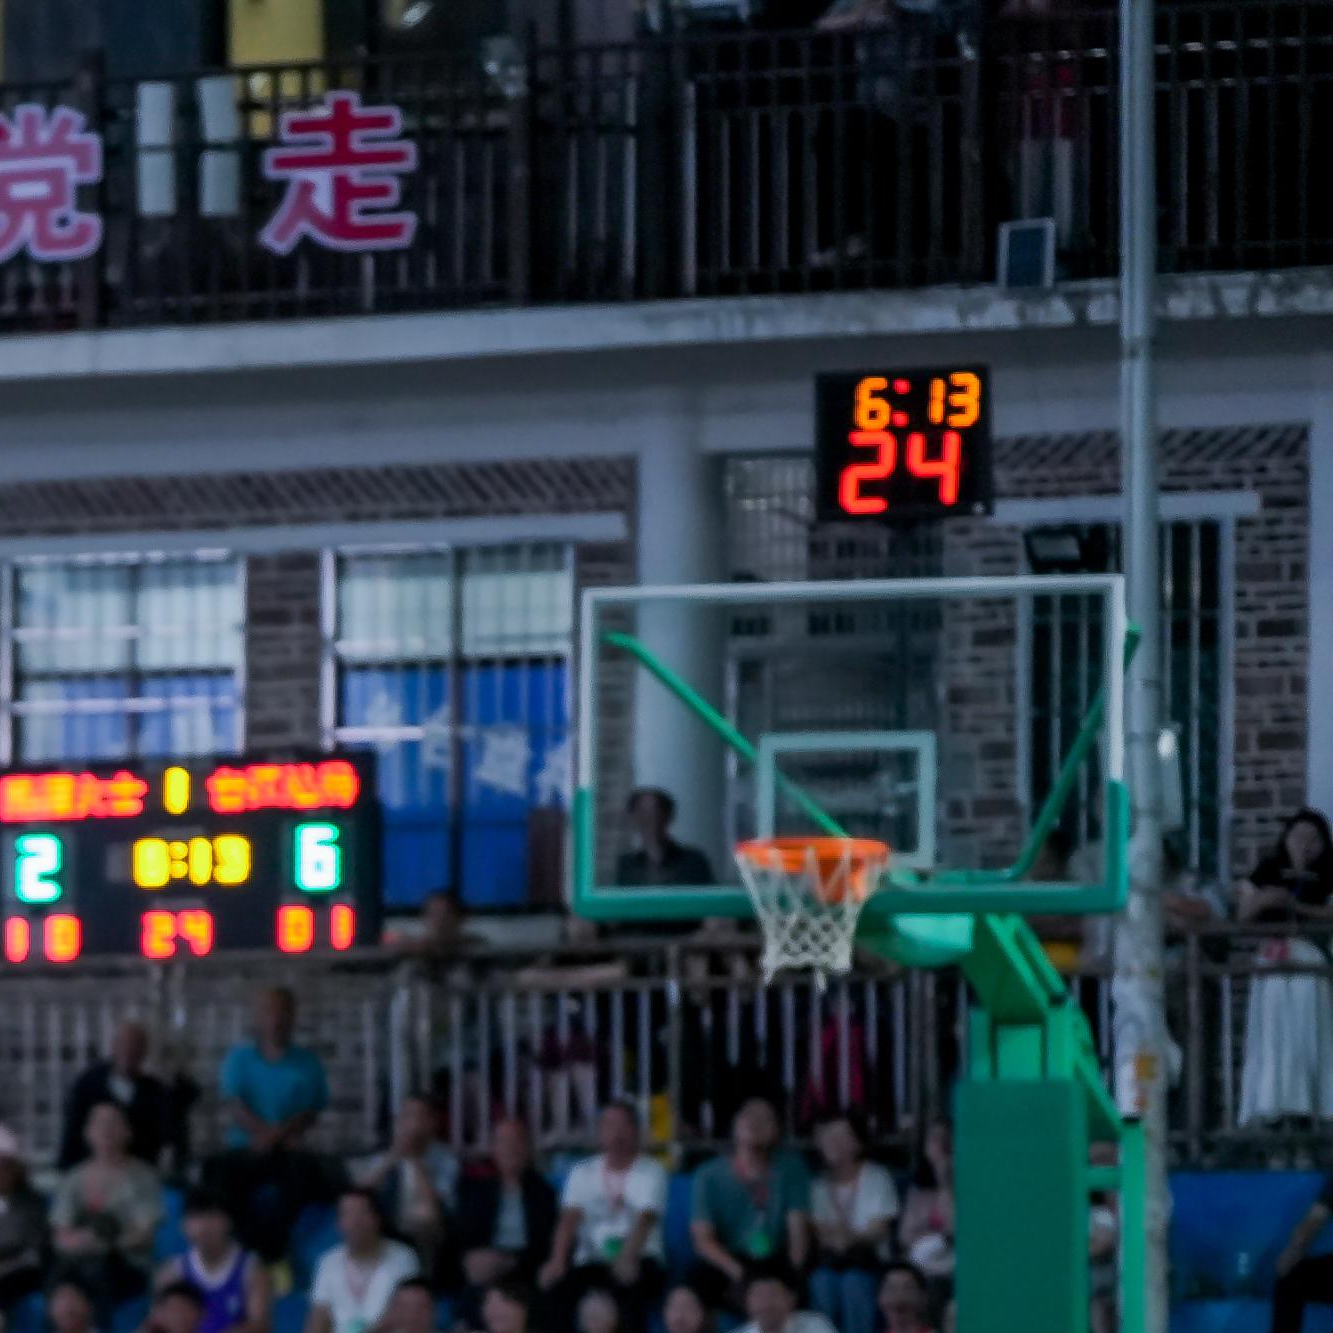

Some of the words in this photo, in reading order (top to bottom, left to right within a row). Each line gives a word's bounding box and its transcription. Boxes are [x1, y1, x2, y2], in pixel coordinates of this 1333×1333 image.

[853, 371, 982, 431] 6:13
[838, 430, 962, 515] 24
[14, 832, 63, 903] 2
[294, 822, 343, 891] 6
[141, 908, 214, 959] 24
